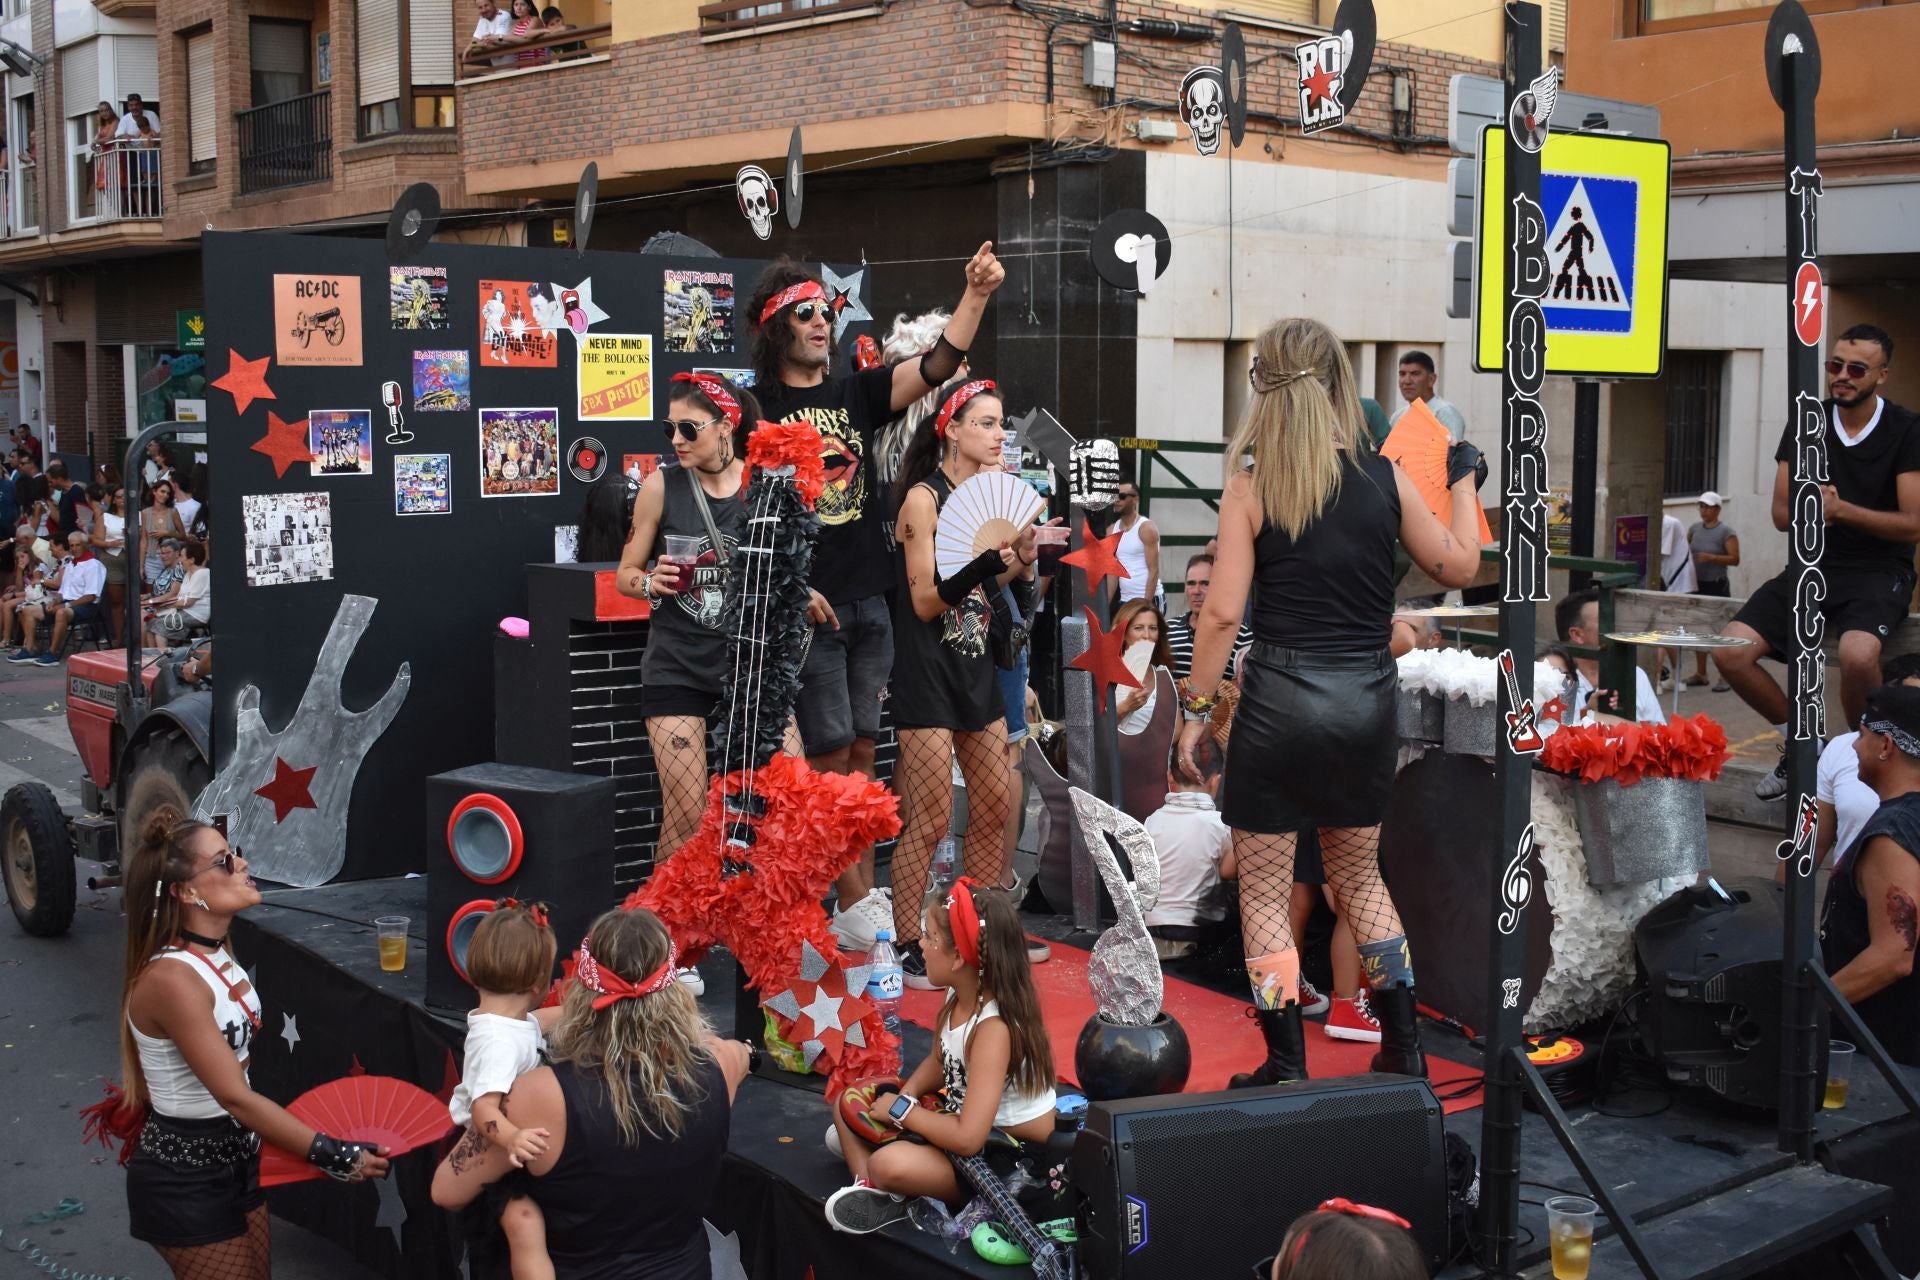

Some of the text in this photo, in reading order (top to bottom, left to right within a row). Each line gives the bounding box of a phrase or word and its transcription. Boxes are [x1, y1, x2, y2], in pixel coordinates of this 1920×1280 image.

[664, 270, 734, 288] IRON MAIDEN
[589, 338, 642, 350] NEVER MIND
[582, 353, 650, 364] THE BOLLOCKS
[1504, 192, 1551, 602] BORN
[1792, 390, 1830, 740] ROCK
